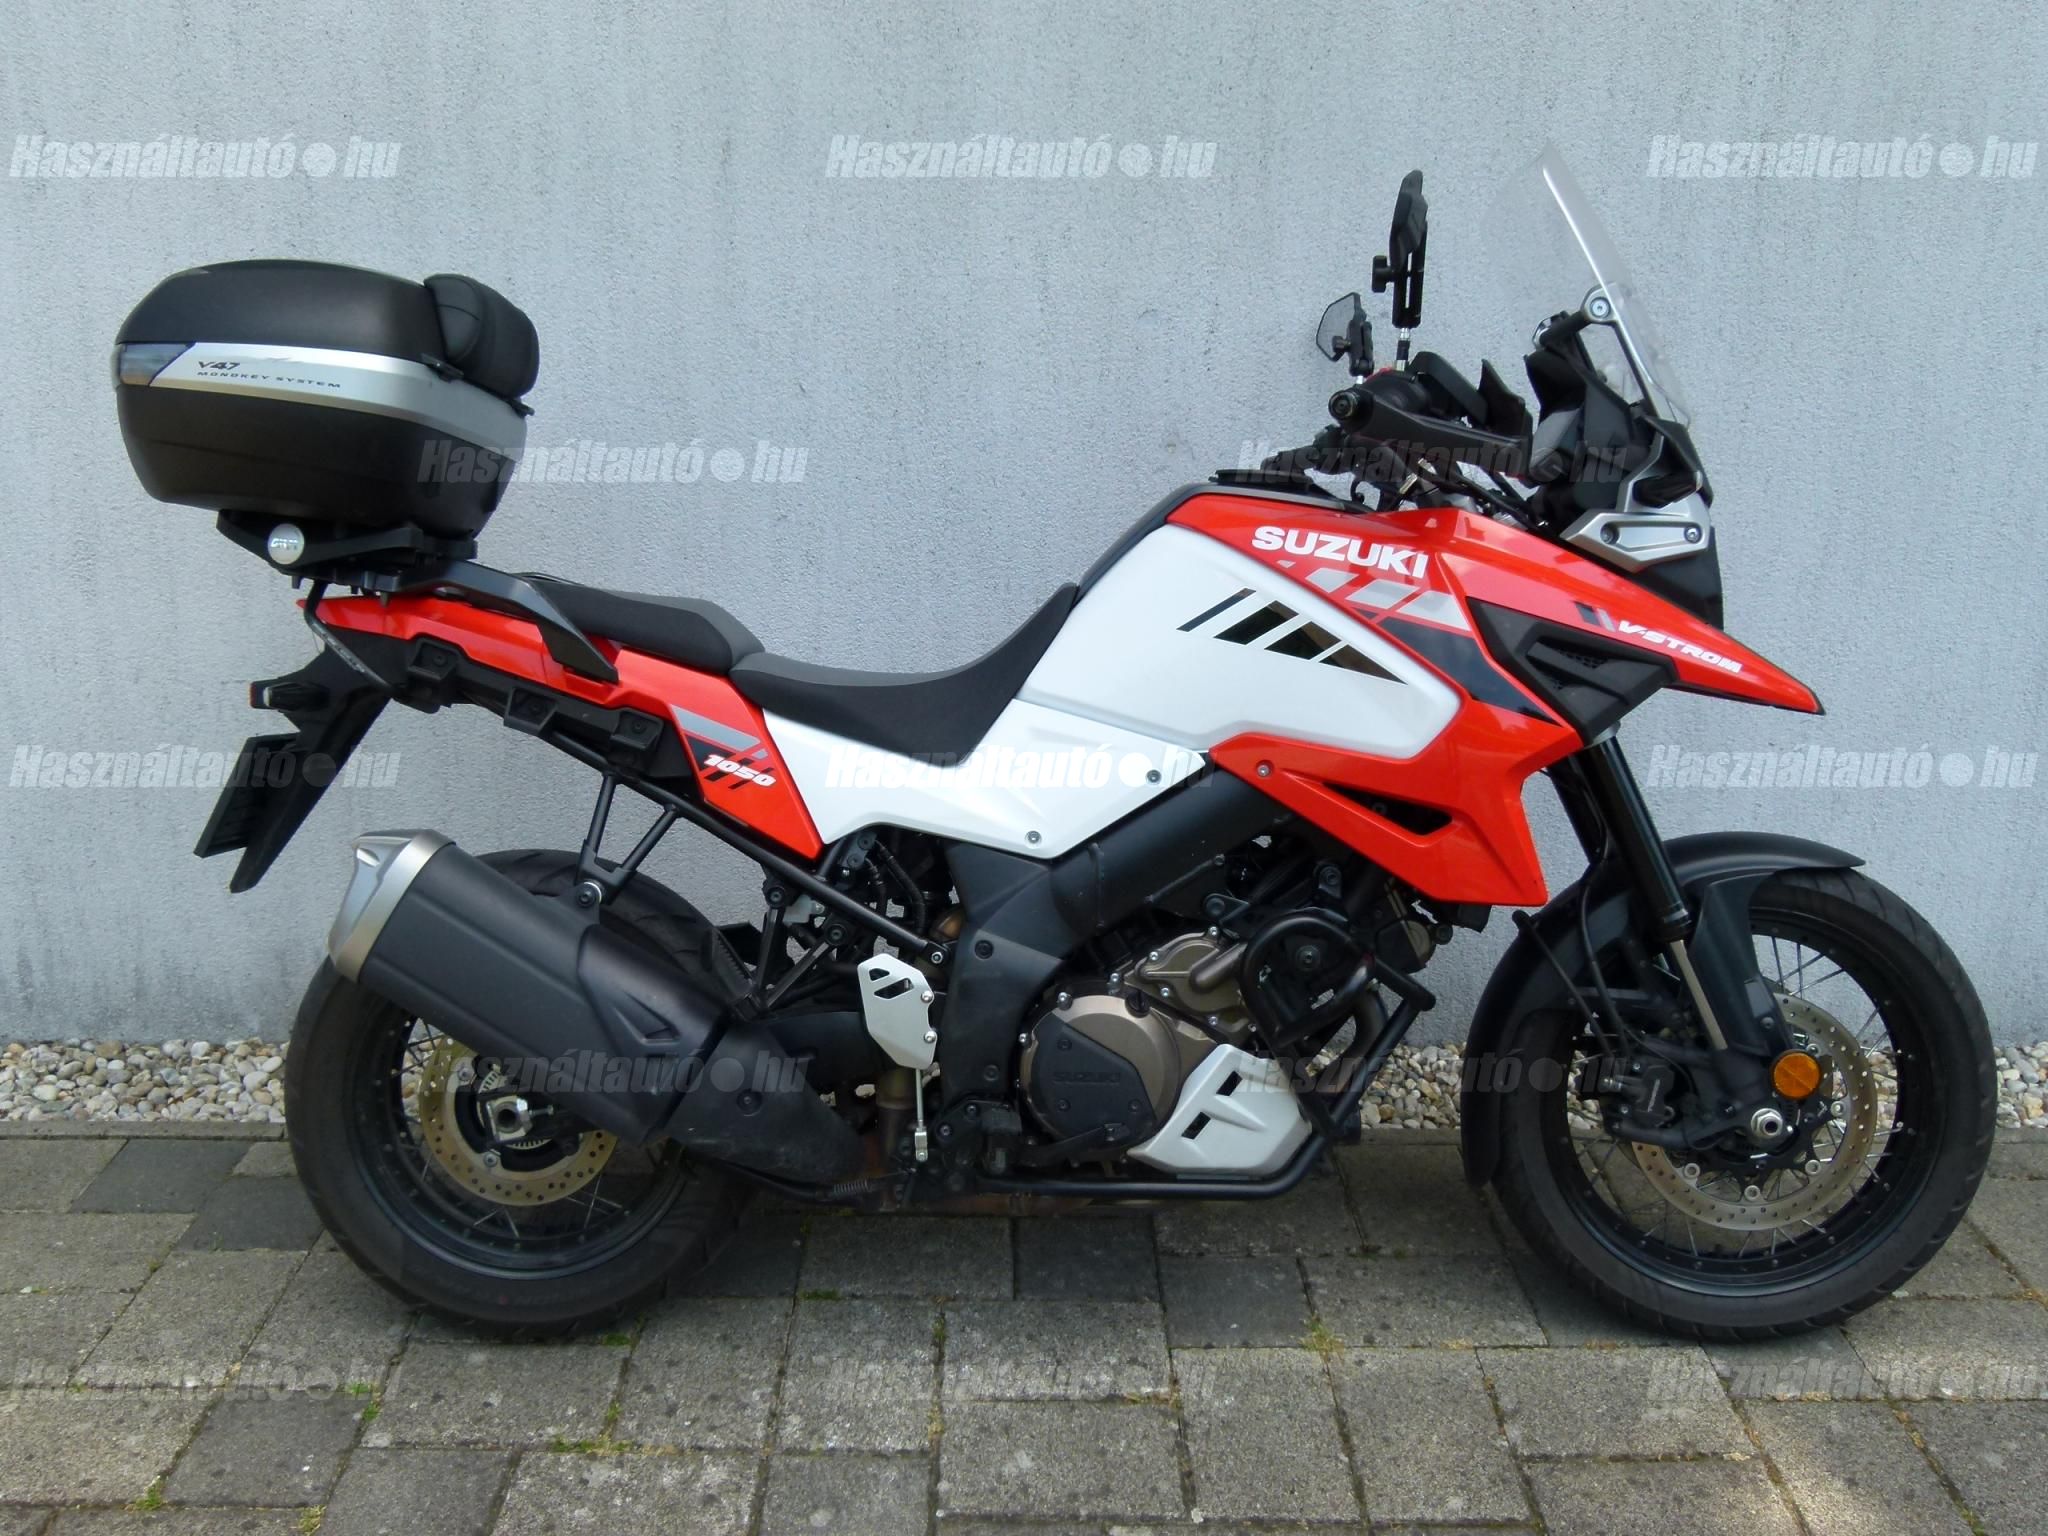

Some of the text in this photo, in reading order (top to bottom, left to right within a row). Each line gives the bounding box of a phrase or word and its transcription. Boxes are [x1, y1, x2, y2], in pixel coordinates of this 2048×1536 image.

[197, 371, 341, 388] MONOKEY SYSTEM
[198, 361, 241, 370] V47
[1252, 525, 1429, 579] SUZUKI
[1618, 619, 1743, 673] V-STROM
[704, 754, 777, 787] 1050
